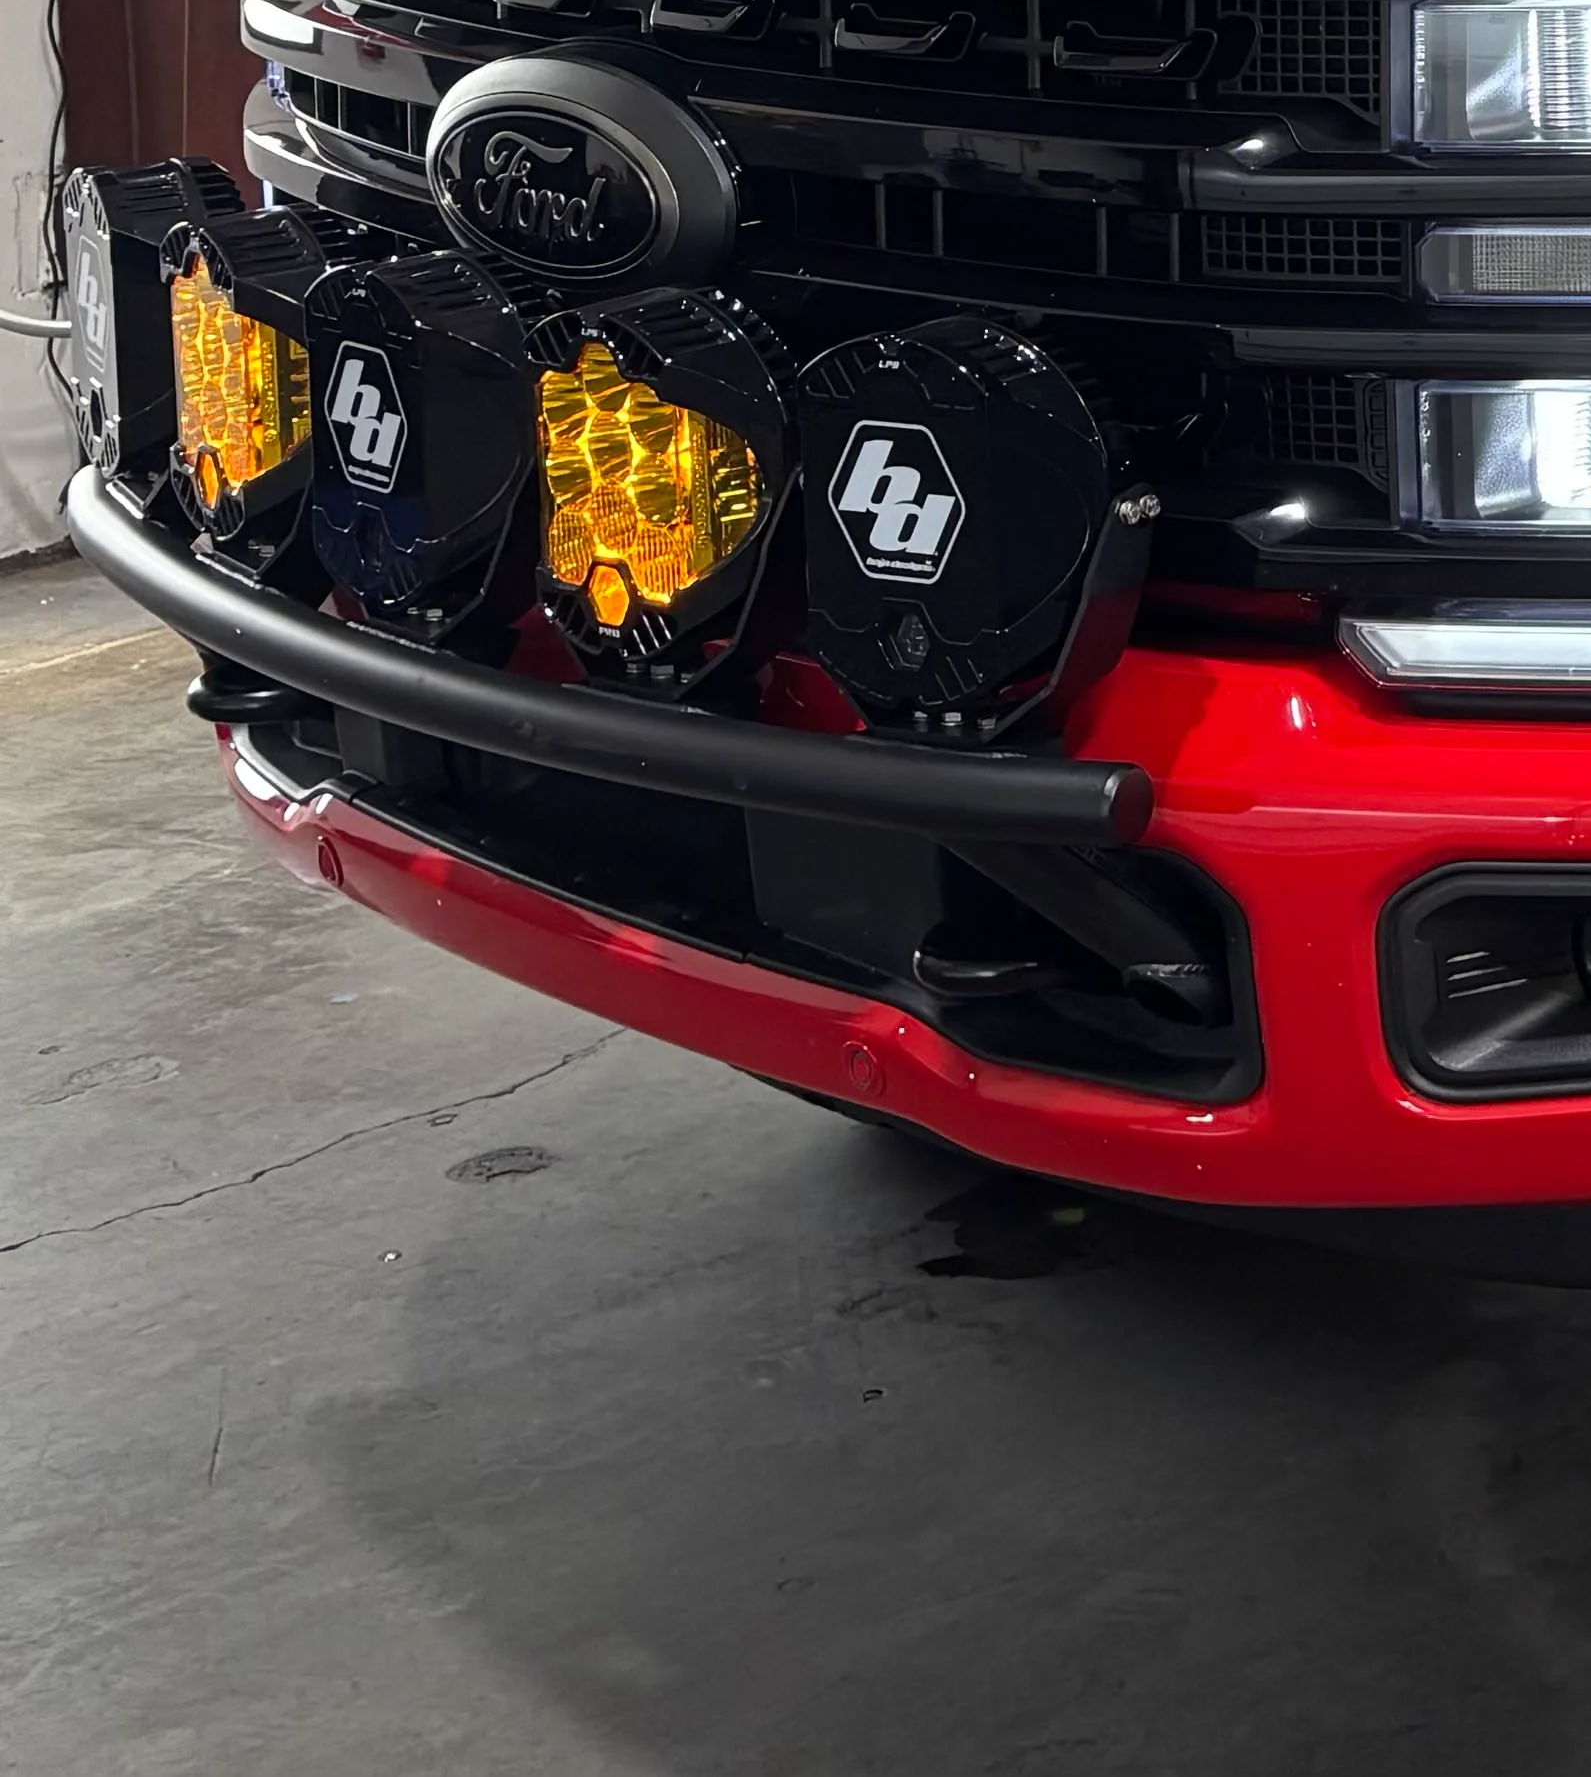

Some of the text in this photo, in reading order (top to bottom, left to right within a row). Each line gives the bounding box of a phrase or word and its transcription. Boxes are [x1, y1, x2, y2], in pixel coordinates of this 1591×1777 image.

[474, 131, 606, 243] Ford
[330, 359, 402, 467] bd
[837, 439, 956, 555] bd
